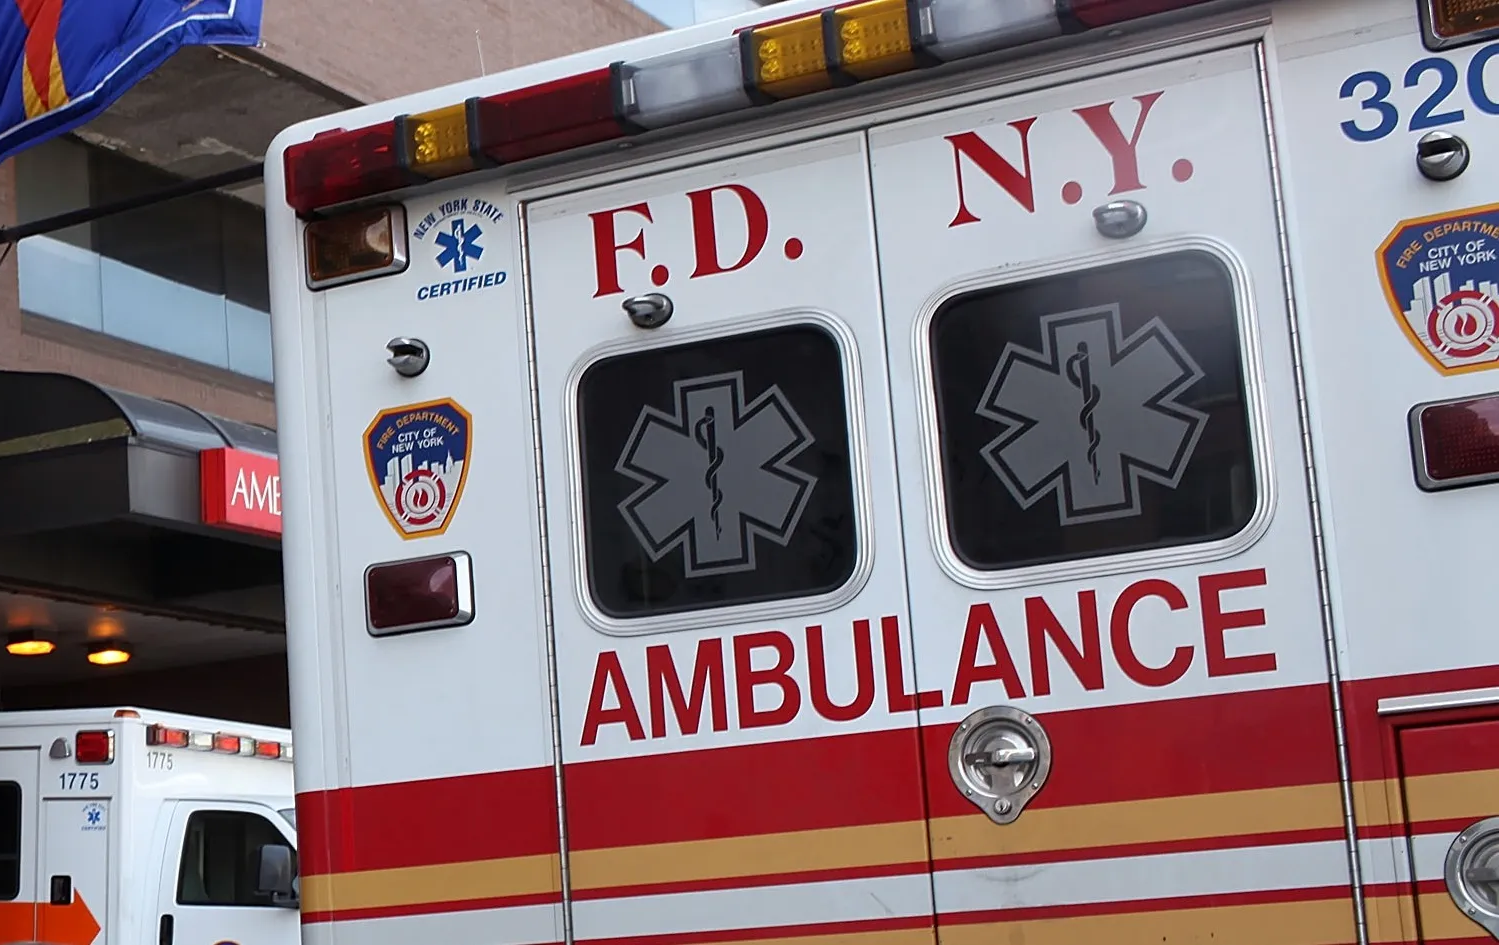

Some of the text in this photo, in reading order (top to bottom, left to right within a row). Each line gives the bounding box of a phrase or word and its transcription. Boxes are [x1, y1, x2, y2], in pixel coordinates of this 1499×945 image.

[413, 212, 436, 240] NEW
[438, 198, 468, 216] YORK
[472, 199, 504, 224] STATE
[1396, 240, 1422, 269] FIRE
[1419, 248, 1497, 273] NEW YORK
[1428, 239, 1486, 260] CITY OF
[417, 271, 507, 301] CERTIFIED
[376, 411, 460, 450] FIRE DEPARTMENT
[398, 427, 437, 443] CITY OF
[392, 435, 444, 454] NEW YORK
[579, 567, 1278, 747] AMBULANCE
[147, 751, 173, 771] 1775
[59, 772, 99, 790] 1775
